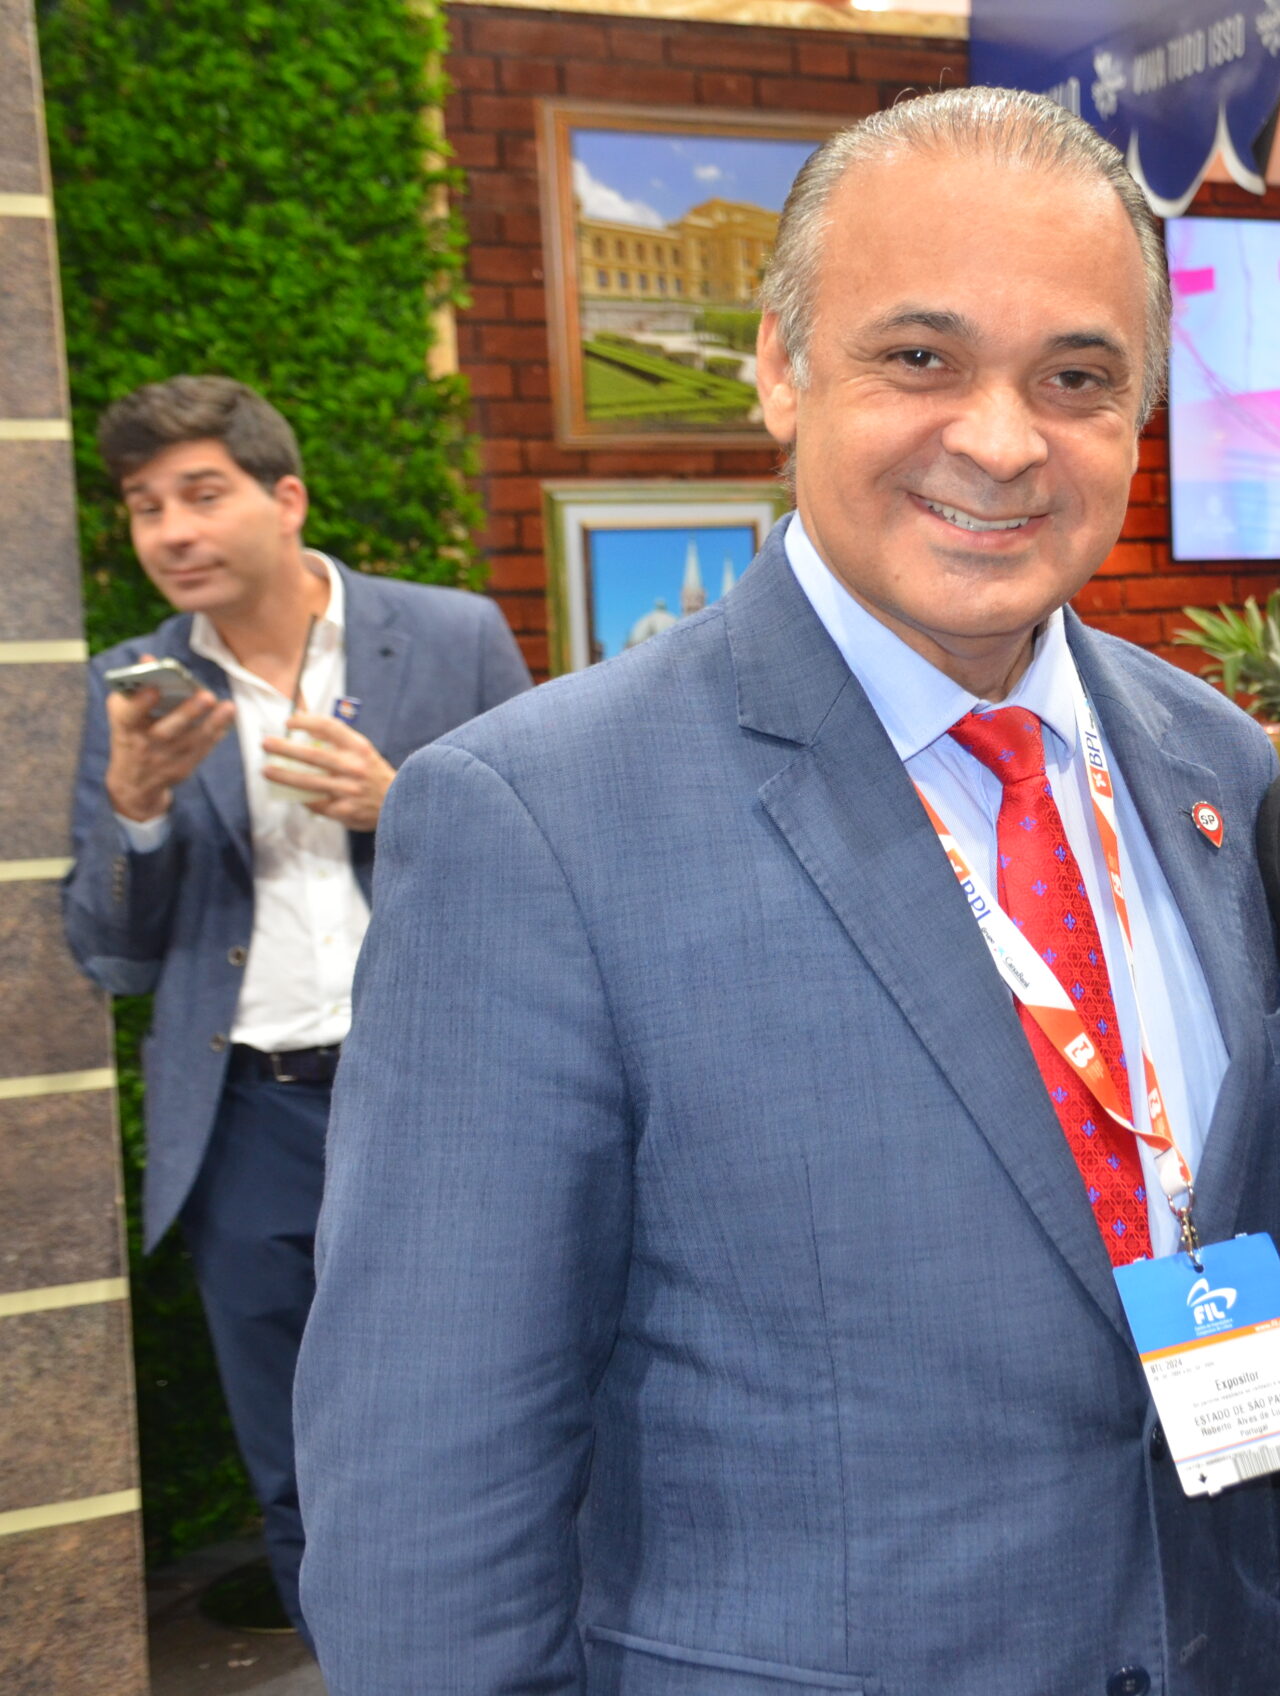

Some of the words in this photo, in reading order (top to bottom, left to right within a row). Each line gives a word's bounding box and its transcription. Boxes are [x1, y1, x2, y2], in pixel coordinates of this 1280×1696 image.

[1085, 730, 1104, 768] BPI
[1200, 814, 1215, 825] SP
[1193, 1302, 1226, 1326] FIL
[1214, 1370, 1260, 1392] Expositor
[1194, 1408, 1231, 1427] ESTADO
[1232, 1404, 1245, 1416] DE
[1201, 1423, 1232, 1437] Roberto
[1237, 1415, 1258, 1427] Alves
